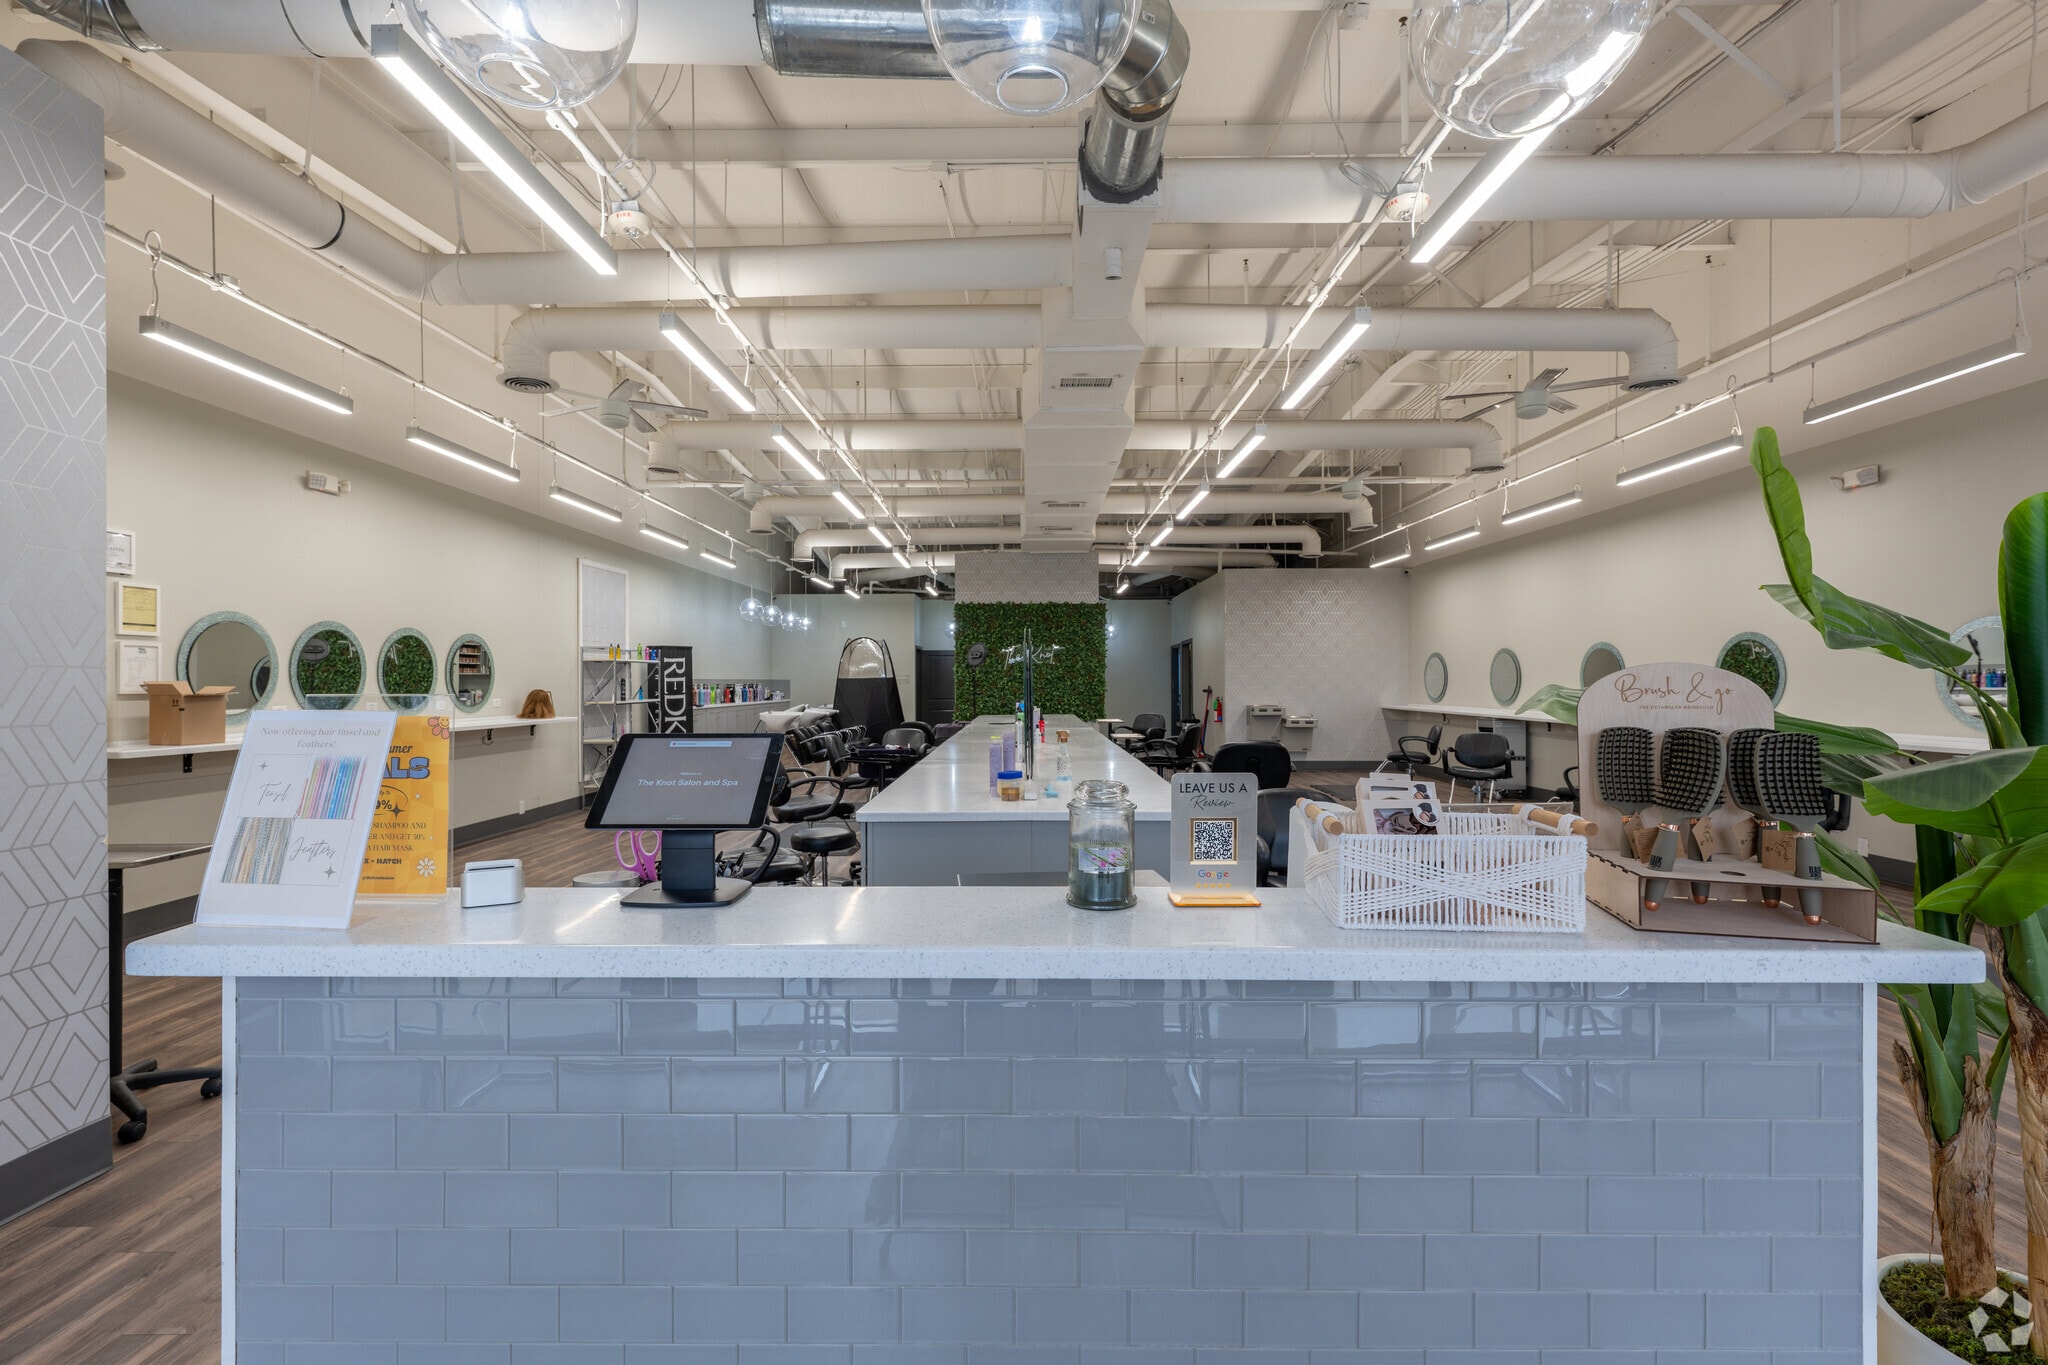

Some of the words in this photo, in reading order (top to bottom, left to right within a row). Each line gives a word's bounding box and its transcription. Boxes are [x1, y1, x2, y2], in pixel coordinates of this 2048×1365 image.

[1031, 643, 1065, 664] Knot
[1614, 673, 1680, 703] Brush
[1686, 672, 1713, 703] &
[1714, 688, 1736, 715] go
[262, 727, 279, 736] Now
[282, 727, 317, 737] offering
[318, 727, 336, 736] hair
[363, 728, 381, 736] and
[722, 779, 738, 787] Spa
[1179, 783, 1215, 793] LEAVE
[1219, 783, 1235, 793] US
[1238, 783, 1248, 793] A
[1190, 793, 1235, 811] Review
